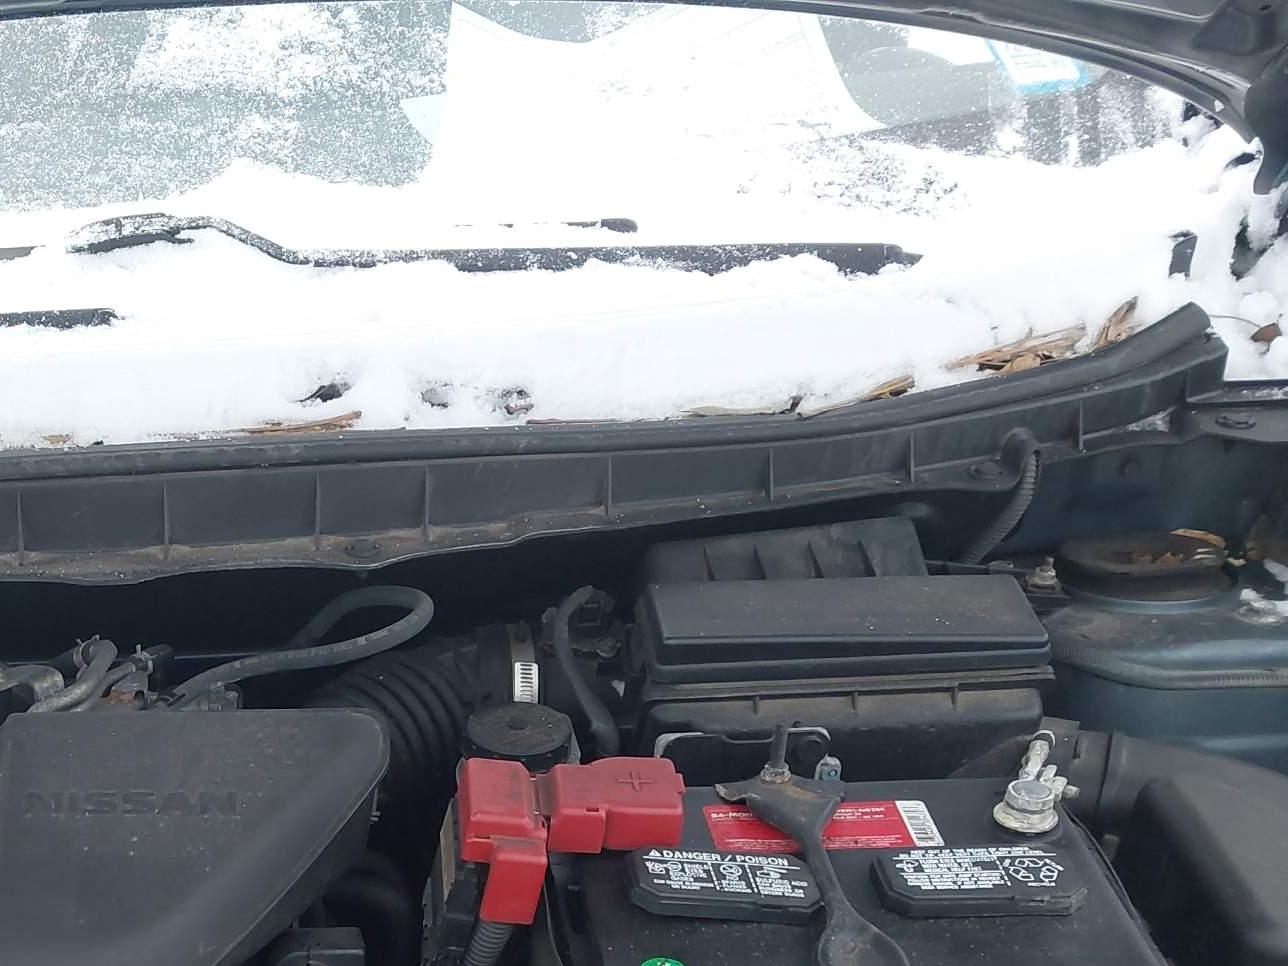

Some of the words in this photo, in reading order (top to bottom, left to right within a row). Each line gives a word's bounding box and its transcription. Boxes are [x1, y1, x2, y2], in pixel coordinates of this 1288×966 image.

[23, 788, 241, 819] NISSAN
[662, 850, 721, 861] DANGER
[724, 854, 732, 862] /
[735, 855, 789, 866] POISON
